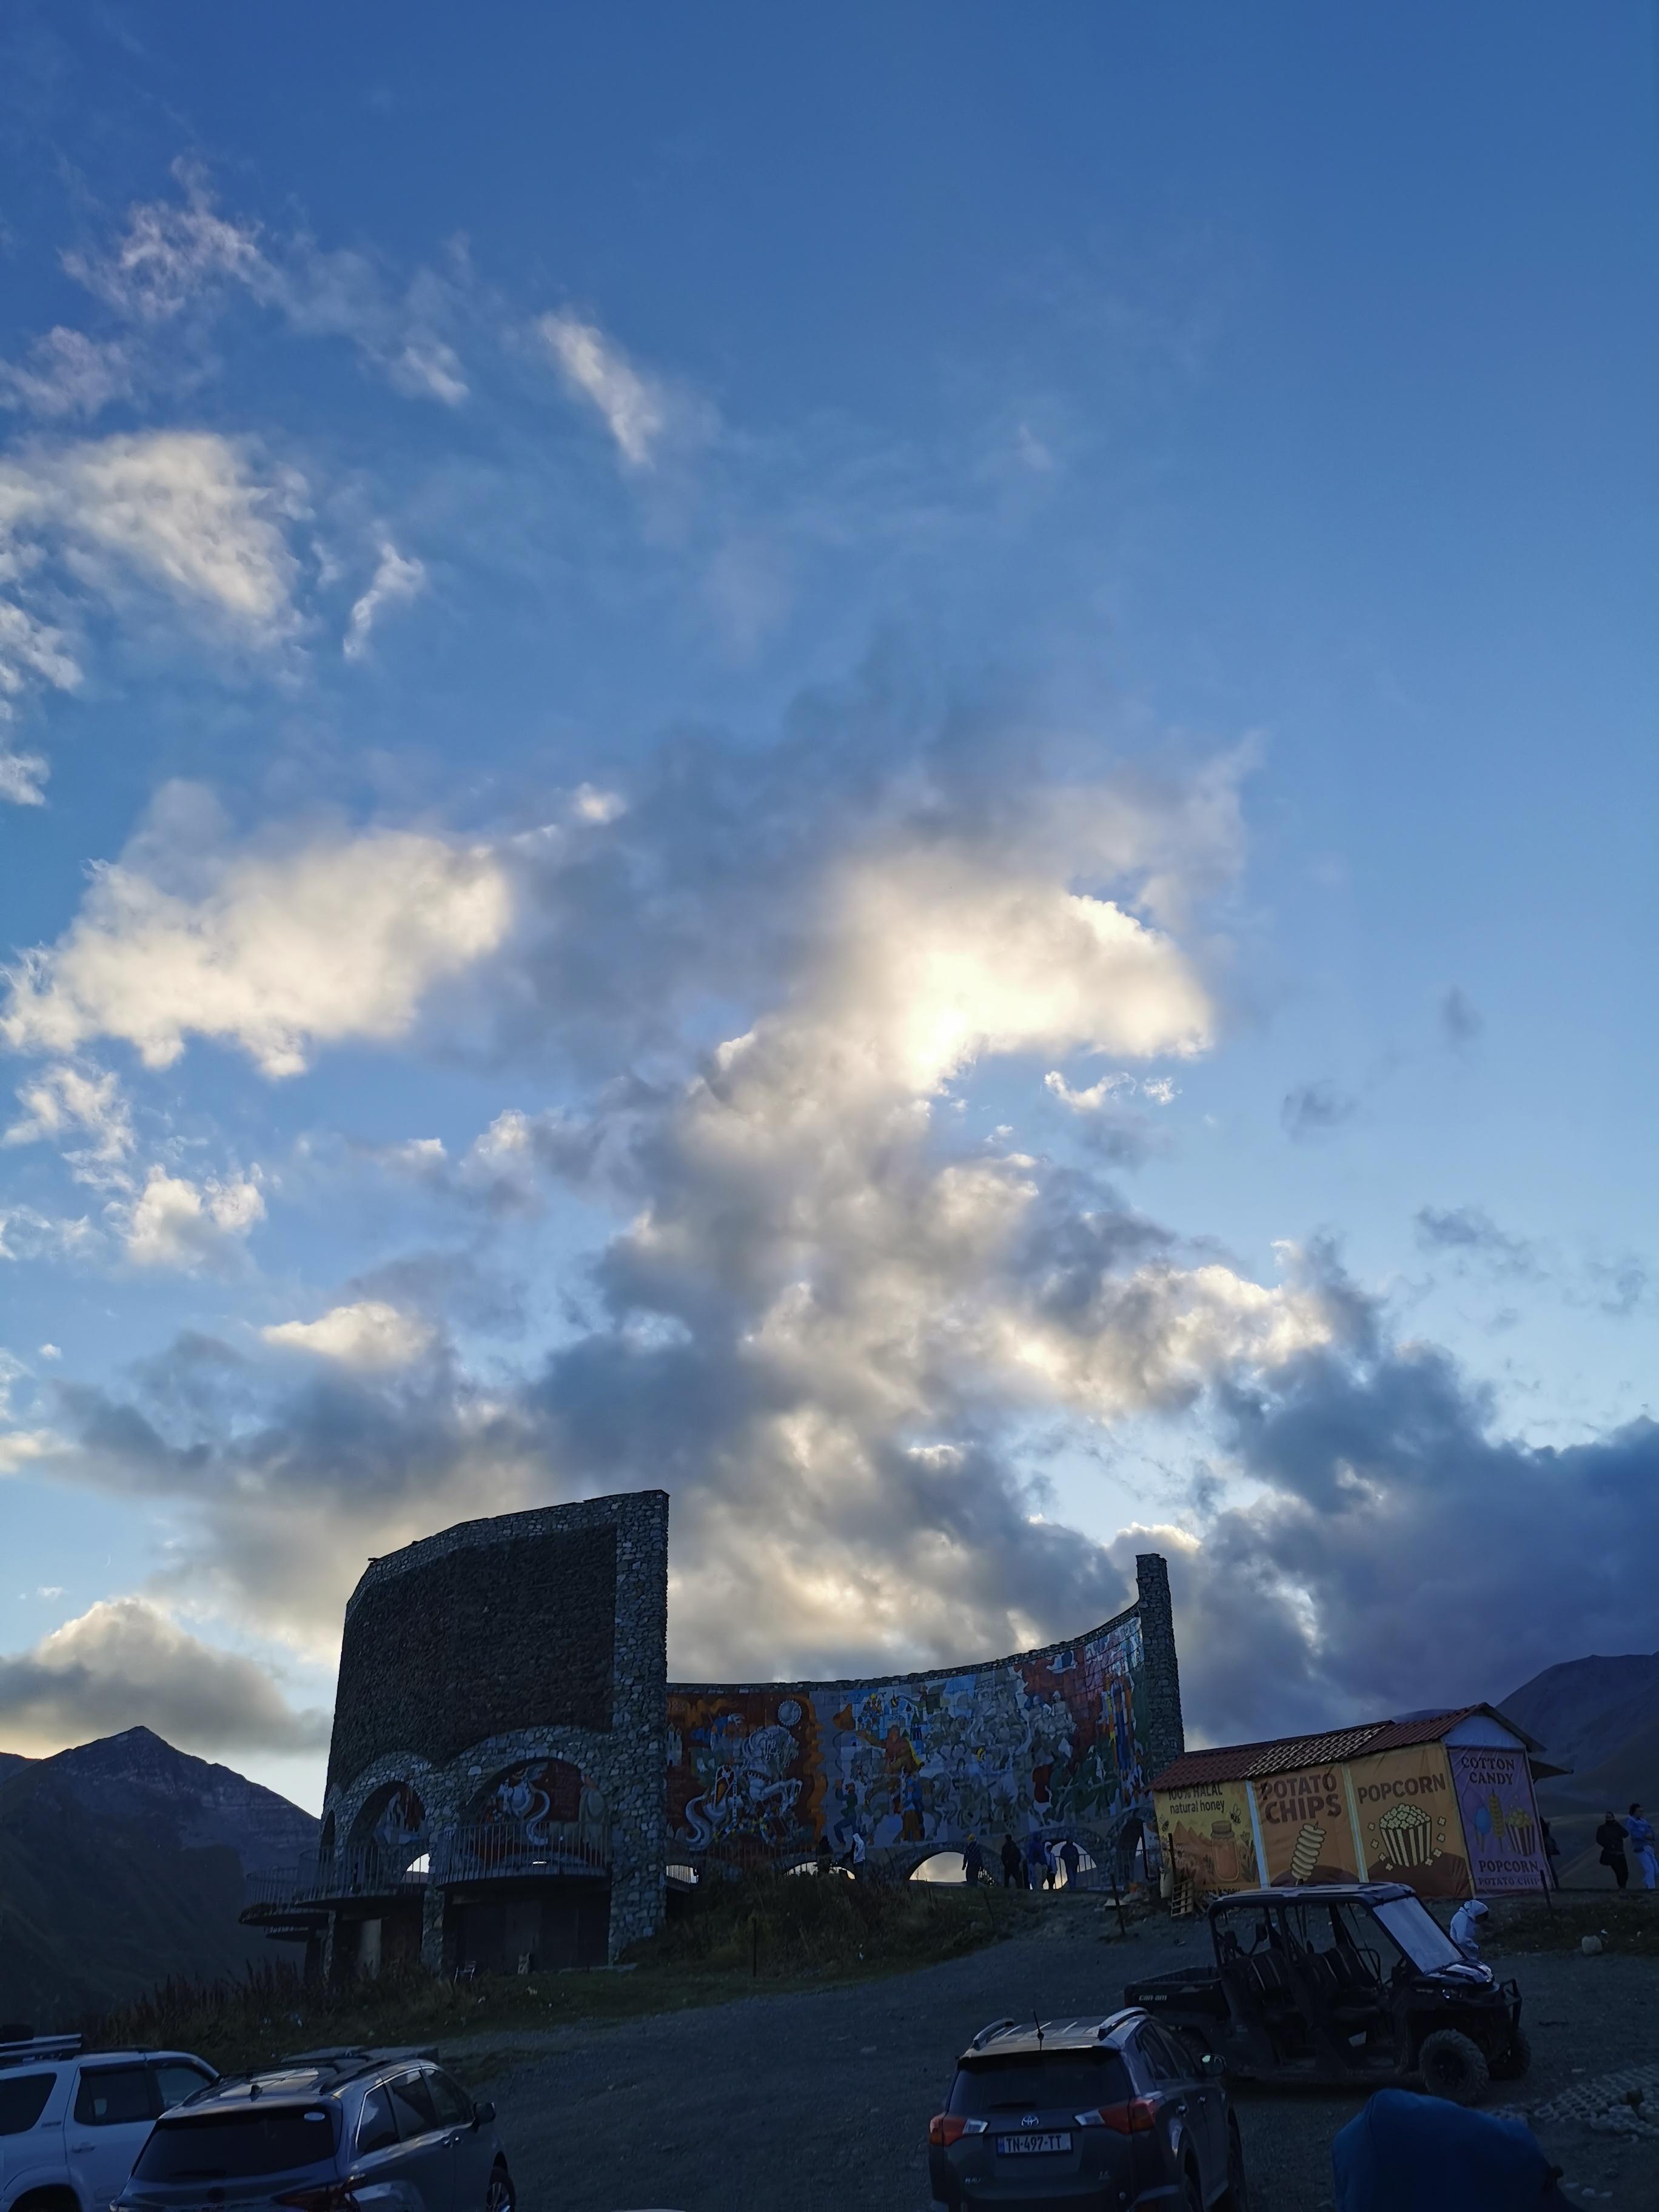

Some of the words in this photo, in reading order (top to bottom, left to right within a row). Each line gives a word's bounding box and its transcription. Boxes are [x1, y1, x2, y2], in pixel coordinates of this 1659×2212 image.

[1461, 1757, 1515, 1771] COTTON
[1261, 1773, 1336, 1800] POTATO
[1469, 1772, 1513, 1785] CANDY
[1168, 1786, 1191, 1800] 100%
[1193, 1782, 1222, 1798] HALAL
[1357, 1773, 1446, 1804] POPCORN
[1170, 1800, 1198, 1815] natural
[1200, 1799, 1224, 1814] honey
[1265, 1794, 1341, 1823] CHIPS
[1478, 1860, 1539, 1872] POPCORN
[1479, 1877, 1515, 1885] POTATO
[1518, 1877, 1544, 1886] CHIP
[1007, 2135, 1062, 2152] TN-497-TT
